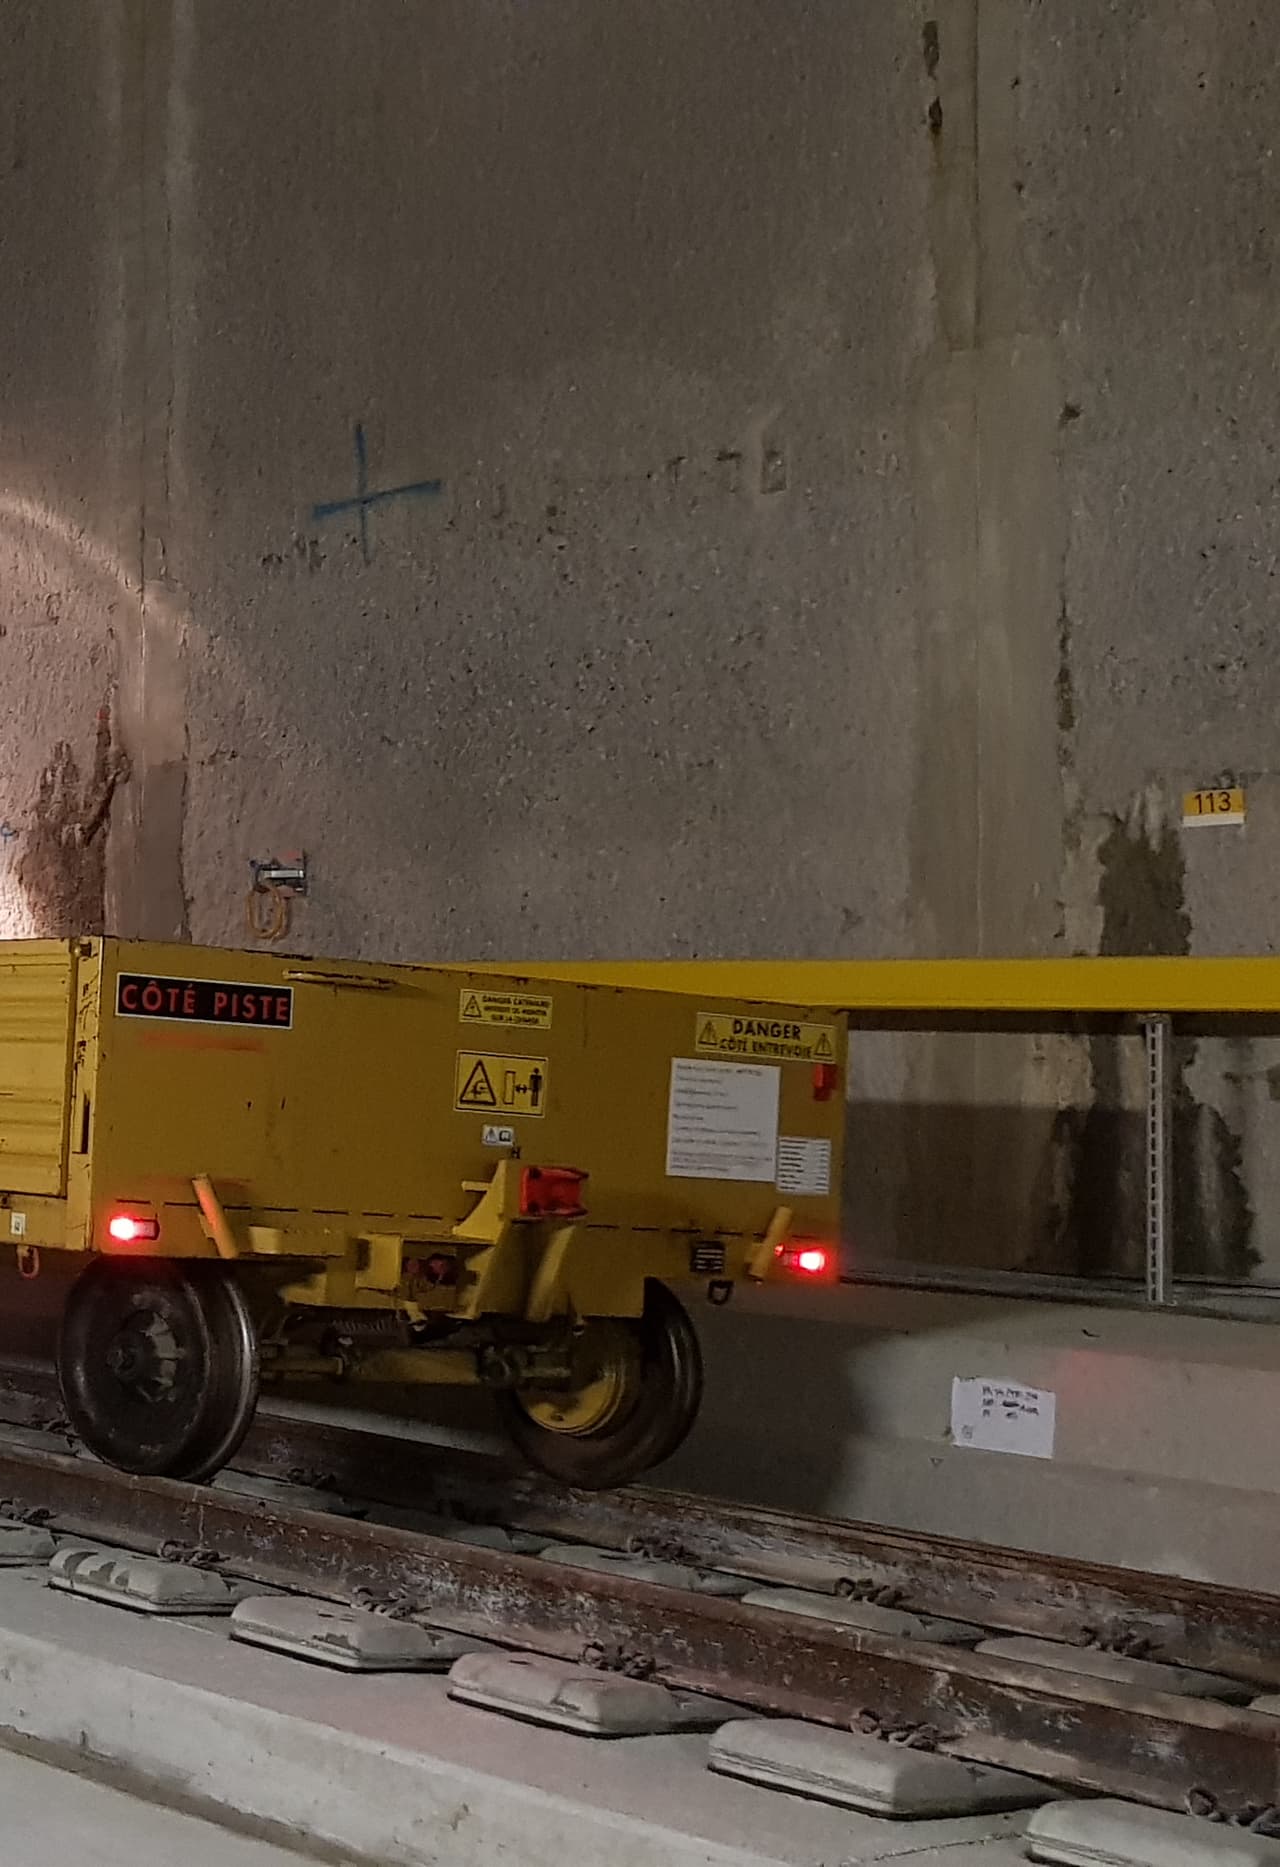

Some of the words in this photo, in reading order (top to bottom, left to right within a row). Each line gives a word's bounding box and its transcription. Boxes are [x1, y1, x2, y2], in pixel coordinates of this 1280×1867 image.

[1193, 791, 1232, 814] 113
[121, 980, 196, 1014] CÔTÉ
[213, 991, 288, 1020] PISTE
[733, 1019, 801, 1040] DANGER
